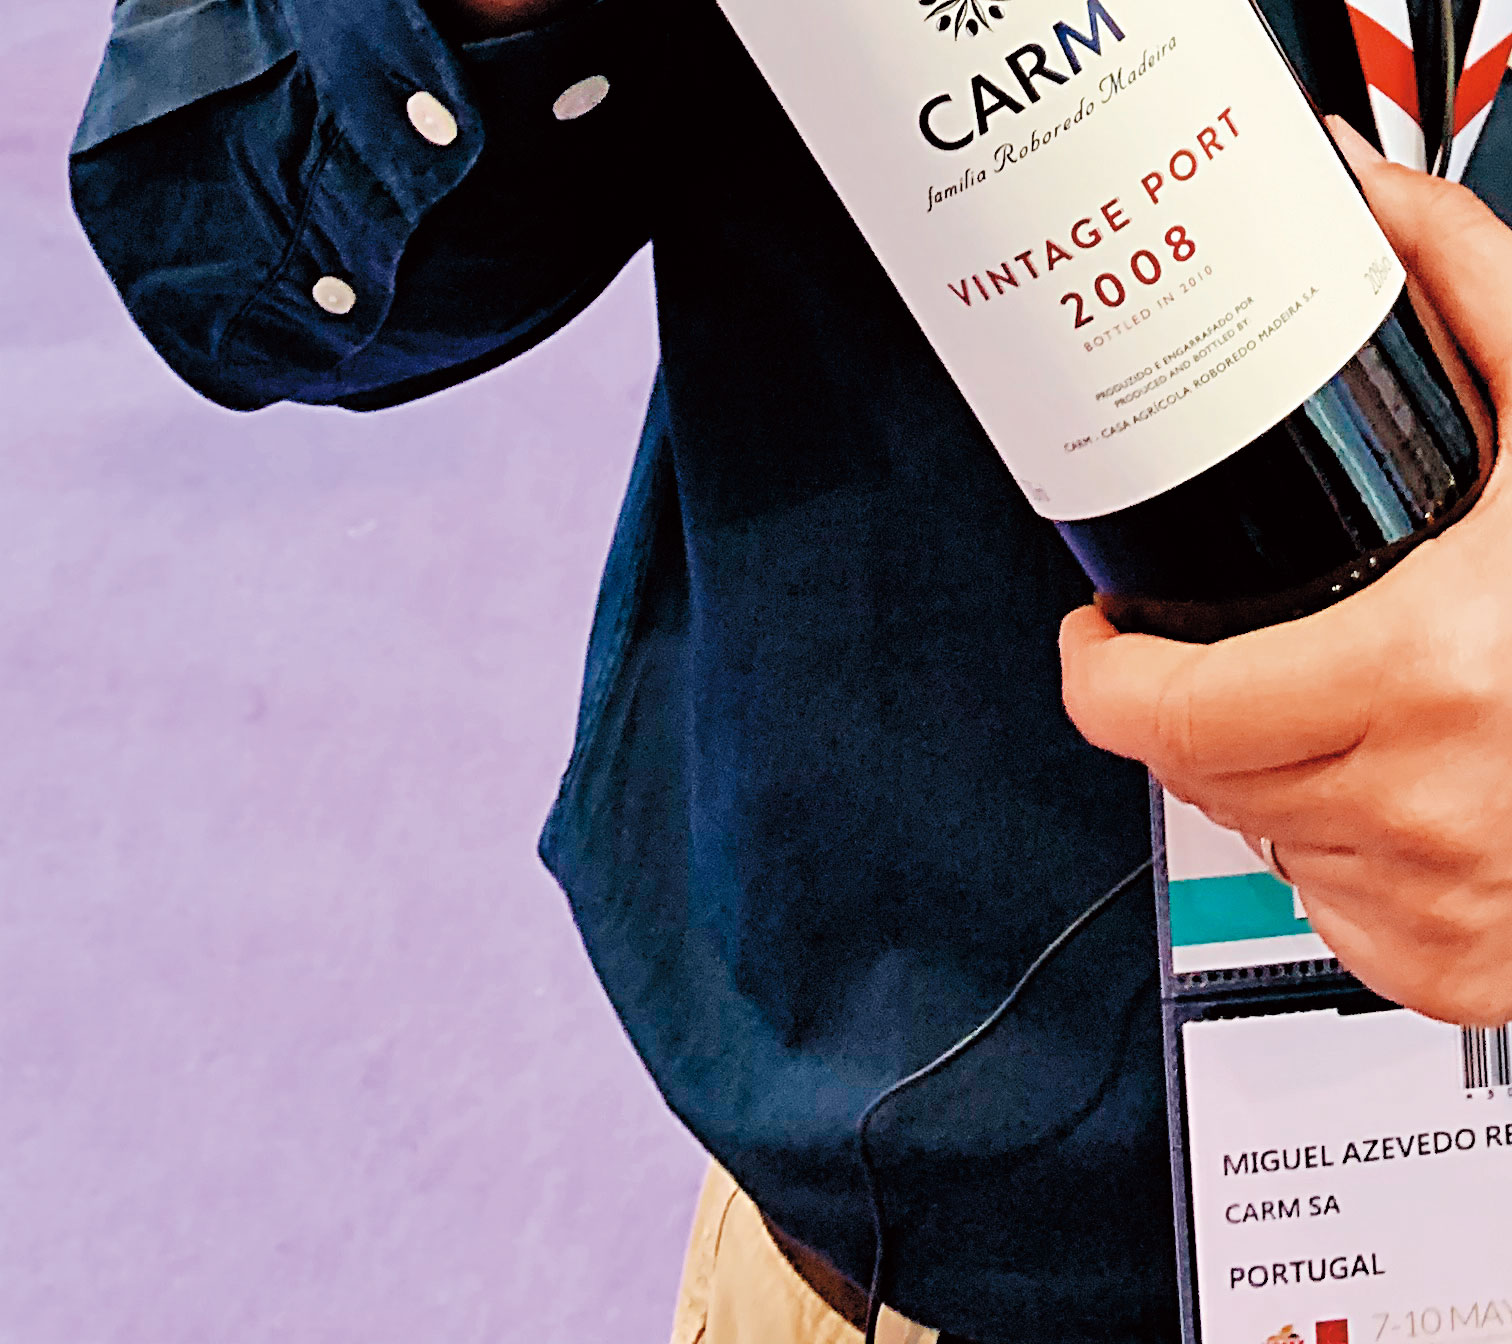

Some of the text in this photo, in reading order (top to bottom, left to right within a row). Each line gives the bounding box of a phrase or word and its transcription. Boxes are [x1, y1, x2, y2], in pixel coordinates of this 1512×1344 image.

[993, 97, 1095, 173] Roboredo
[1098, 36, 1177, 104] Madeira
[947, 107, 1240, 307] VINTAGE PORT
[1059, 225, 1196, 329] 2008
[1083, 264, 1213, 353] BOTTLED IN 2010
[1095, 366, 1153, 402] PRODUZIDO
[1162, 312, 1234, 366] ENGARRAFADO
[1234, 296, 1255, 315] POR
[1101, 419, 1131, 439] CASA
[1132, 386, 1191, 424] AGRÍCOLA
[1192, 340, 1257, 389] ROBOREDO
[1257, 301, 1303, 342] MADEIRA
[1114, 375, 1167, 409] PRODUCED
[1169, 360, 1191, 379] AND
[1192, 329, 1236, 363] BOTTLED
[1222, 1145, 1335, 1176] MIGUEL
[1342, 1128, 1476, 1164] AZEVEDO
[1225, 1195, 1341, 1224] CARM SA
[1229, 1253, 1386, 1290] PORTUGAL
[1371, 1306, 1442, 1342] 7-10
